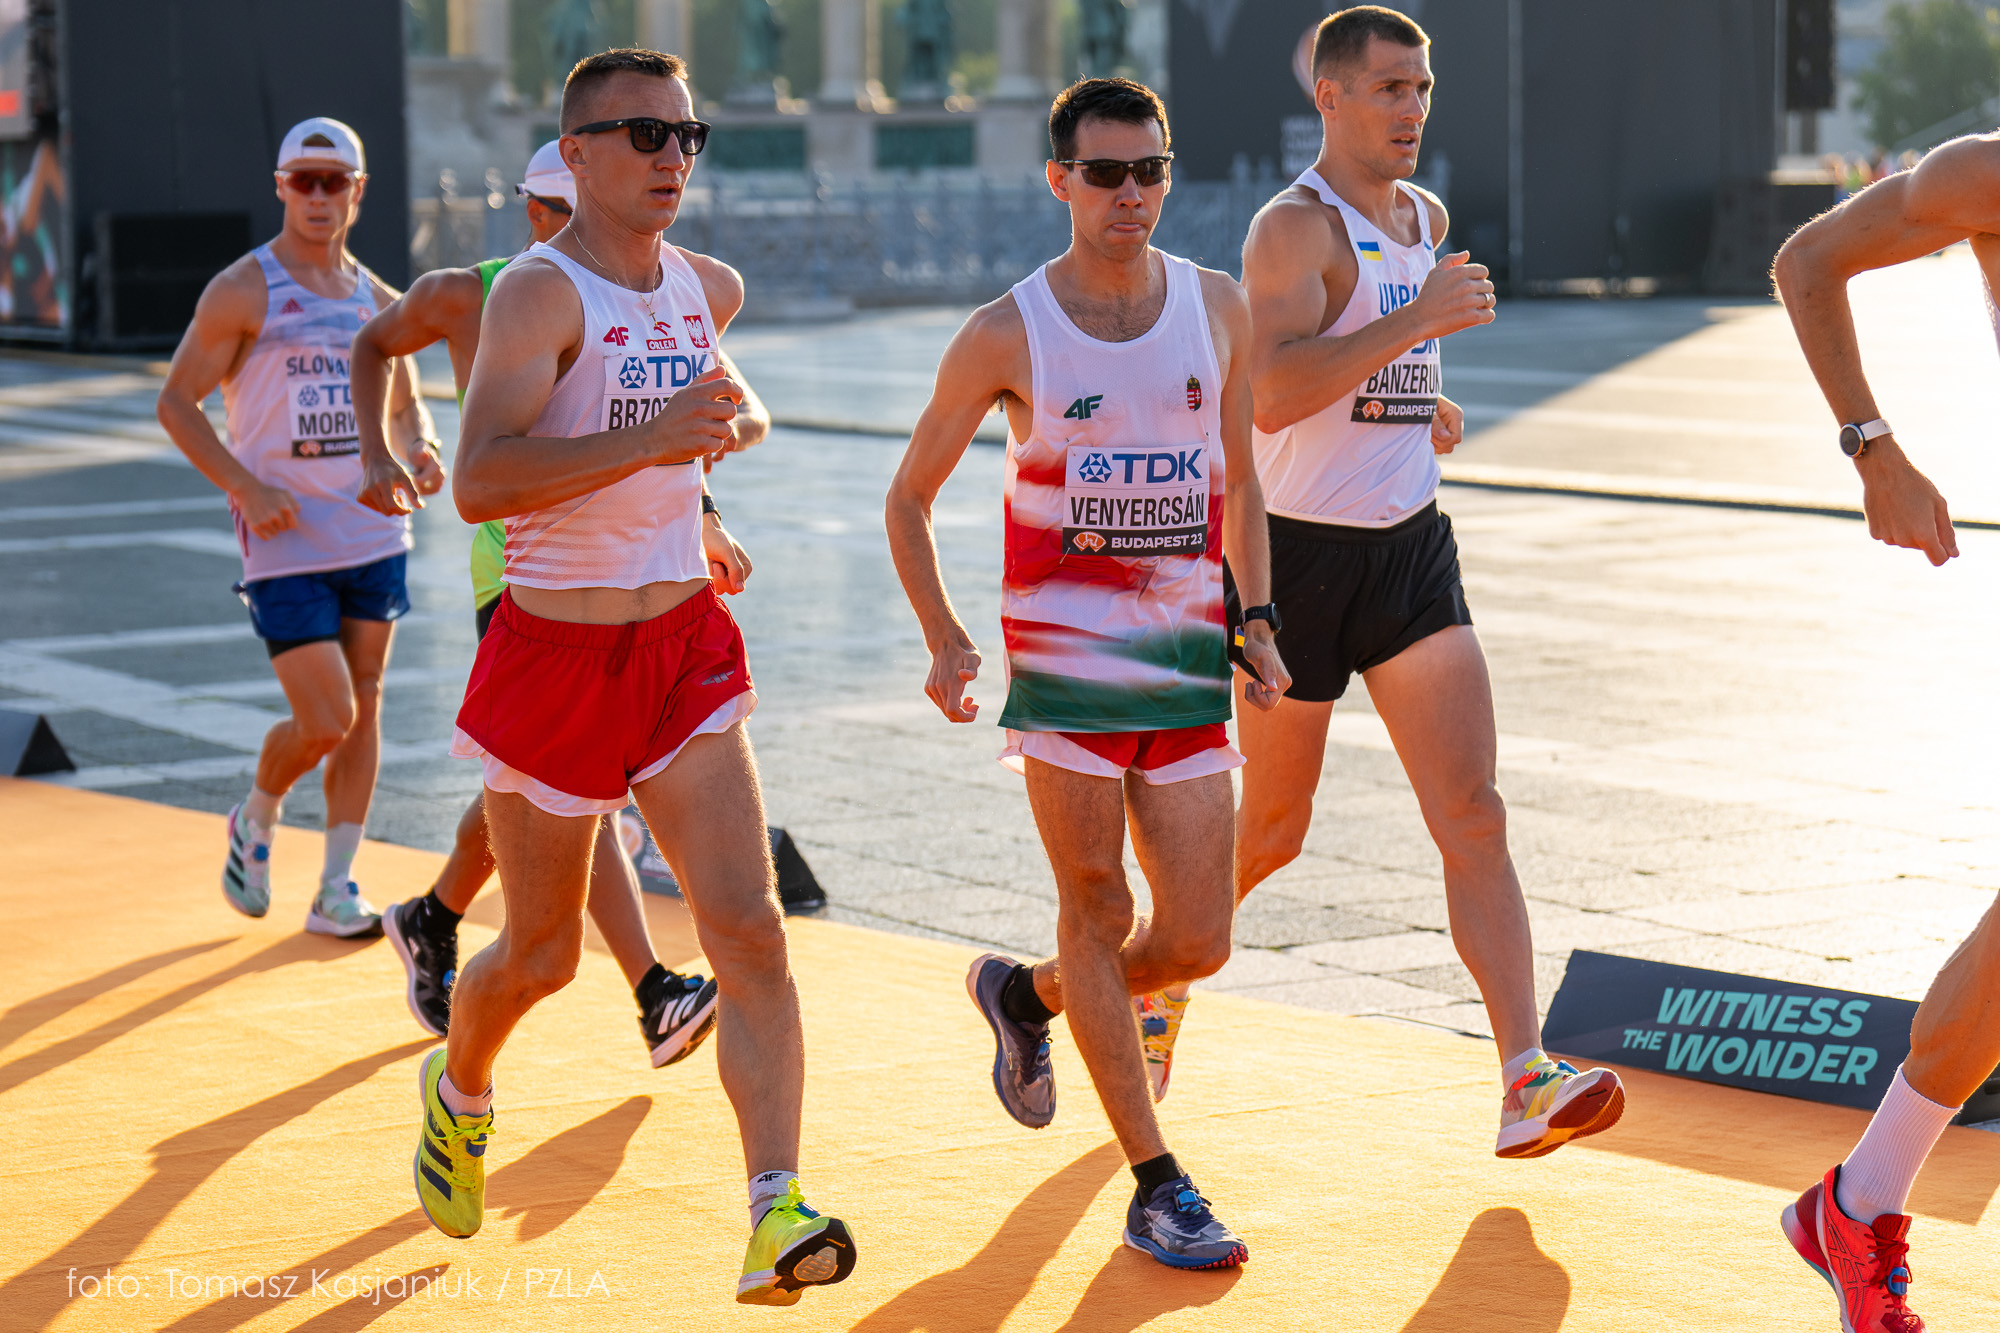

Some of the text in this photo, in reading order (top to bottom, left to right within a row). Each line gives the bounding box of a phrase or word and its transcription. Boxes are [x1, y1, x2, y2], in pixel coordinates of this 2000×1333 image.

[648, 339, 676, 350] ORLEN
[286, 354, 350, 377] SLOVA
[647, 354, 707, 388] TDK
[609, 397, 670, 431] BRZO
[1386, 404, 1434, 416] BUDAPEST
[1112, 448, 1203, 484] TDK
[1070, 488, 1205, 527] VENYERCSÁN
[1111, 533, 1203, 549] BUDAPEST 23
[1656, 987, 1871, 1038] WITNESS
[1622, 1029, 1878, 1085] THE WONDER
